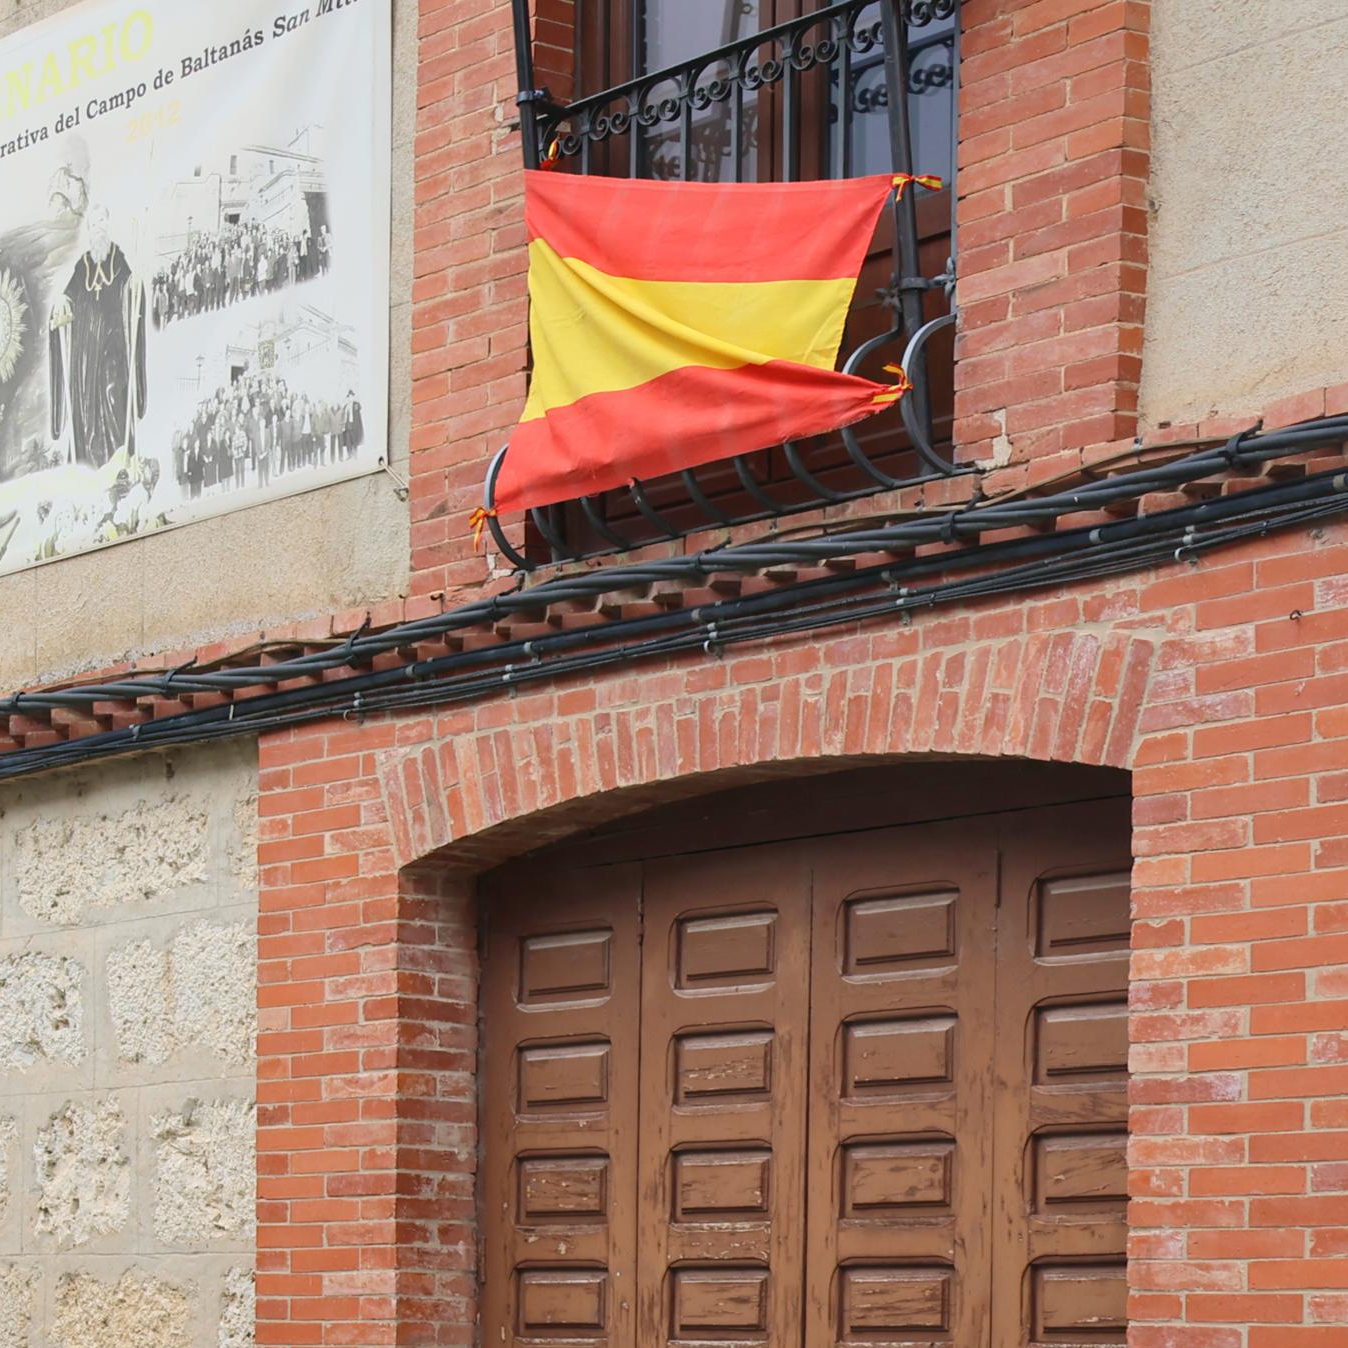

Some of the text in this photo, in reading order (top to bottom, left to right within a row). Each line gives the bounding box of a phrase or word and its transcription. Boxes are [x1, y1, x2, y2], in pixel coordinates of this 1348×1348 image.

[54, 106, 81, 134] del
[86, 81, 148, 120] Campo
[153, 68, 175, 90] de
[180, 28, 265, 79] Baltanás
[272, 9, 311, 39] San
